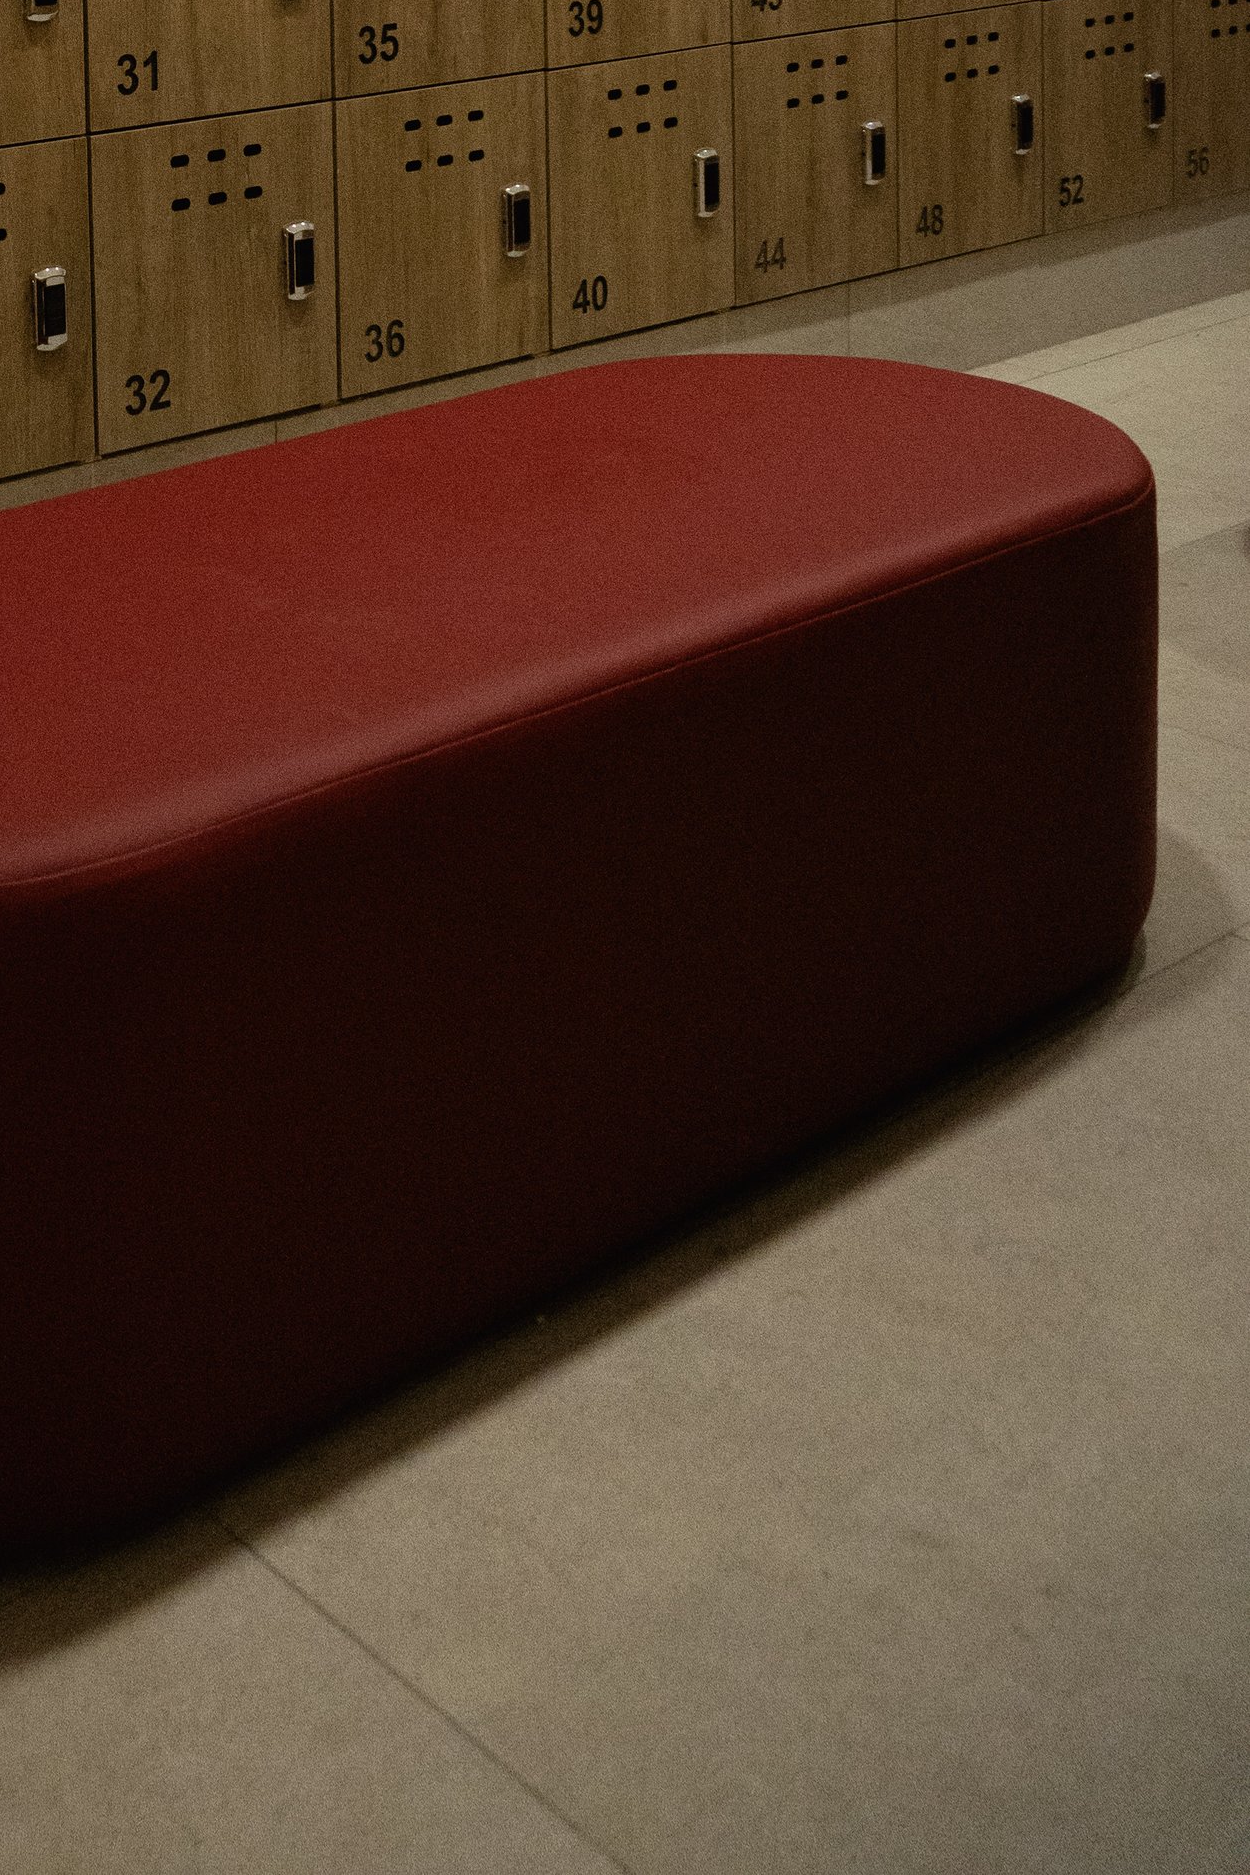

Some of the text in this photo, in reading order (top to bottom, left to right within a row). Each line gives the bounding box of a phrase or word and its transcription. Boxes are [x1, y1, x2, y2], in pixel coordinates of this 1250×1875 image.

[358, 23, 400, 64] 35
[116, 51, 160, 95] 31
[1187, 147, 1209, 178] 56
[1058, 175, 1083, 208] 52
[916, 204, 944, 235] 48
[754, 237, 786, 273] 44
[572, 275, 608, 313] 40
[364, 320, 405, 362] 36
[125, 370, 171, 416] 32
